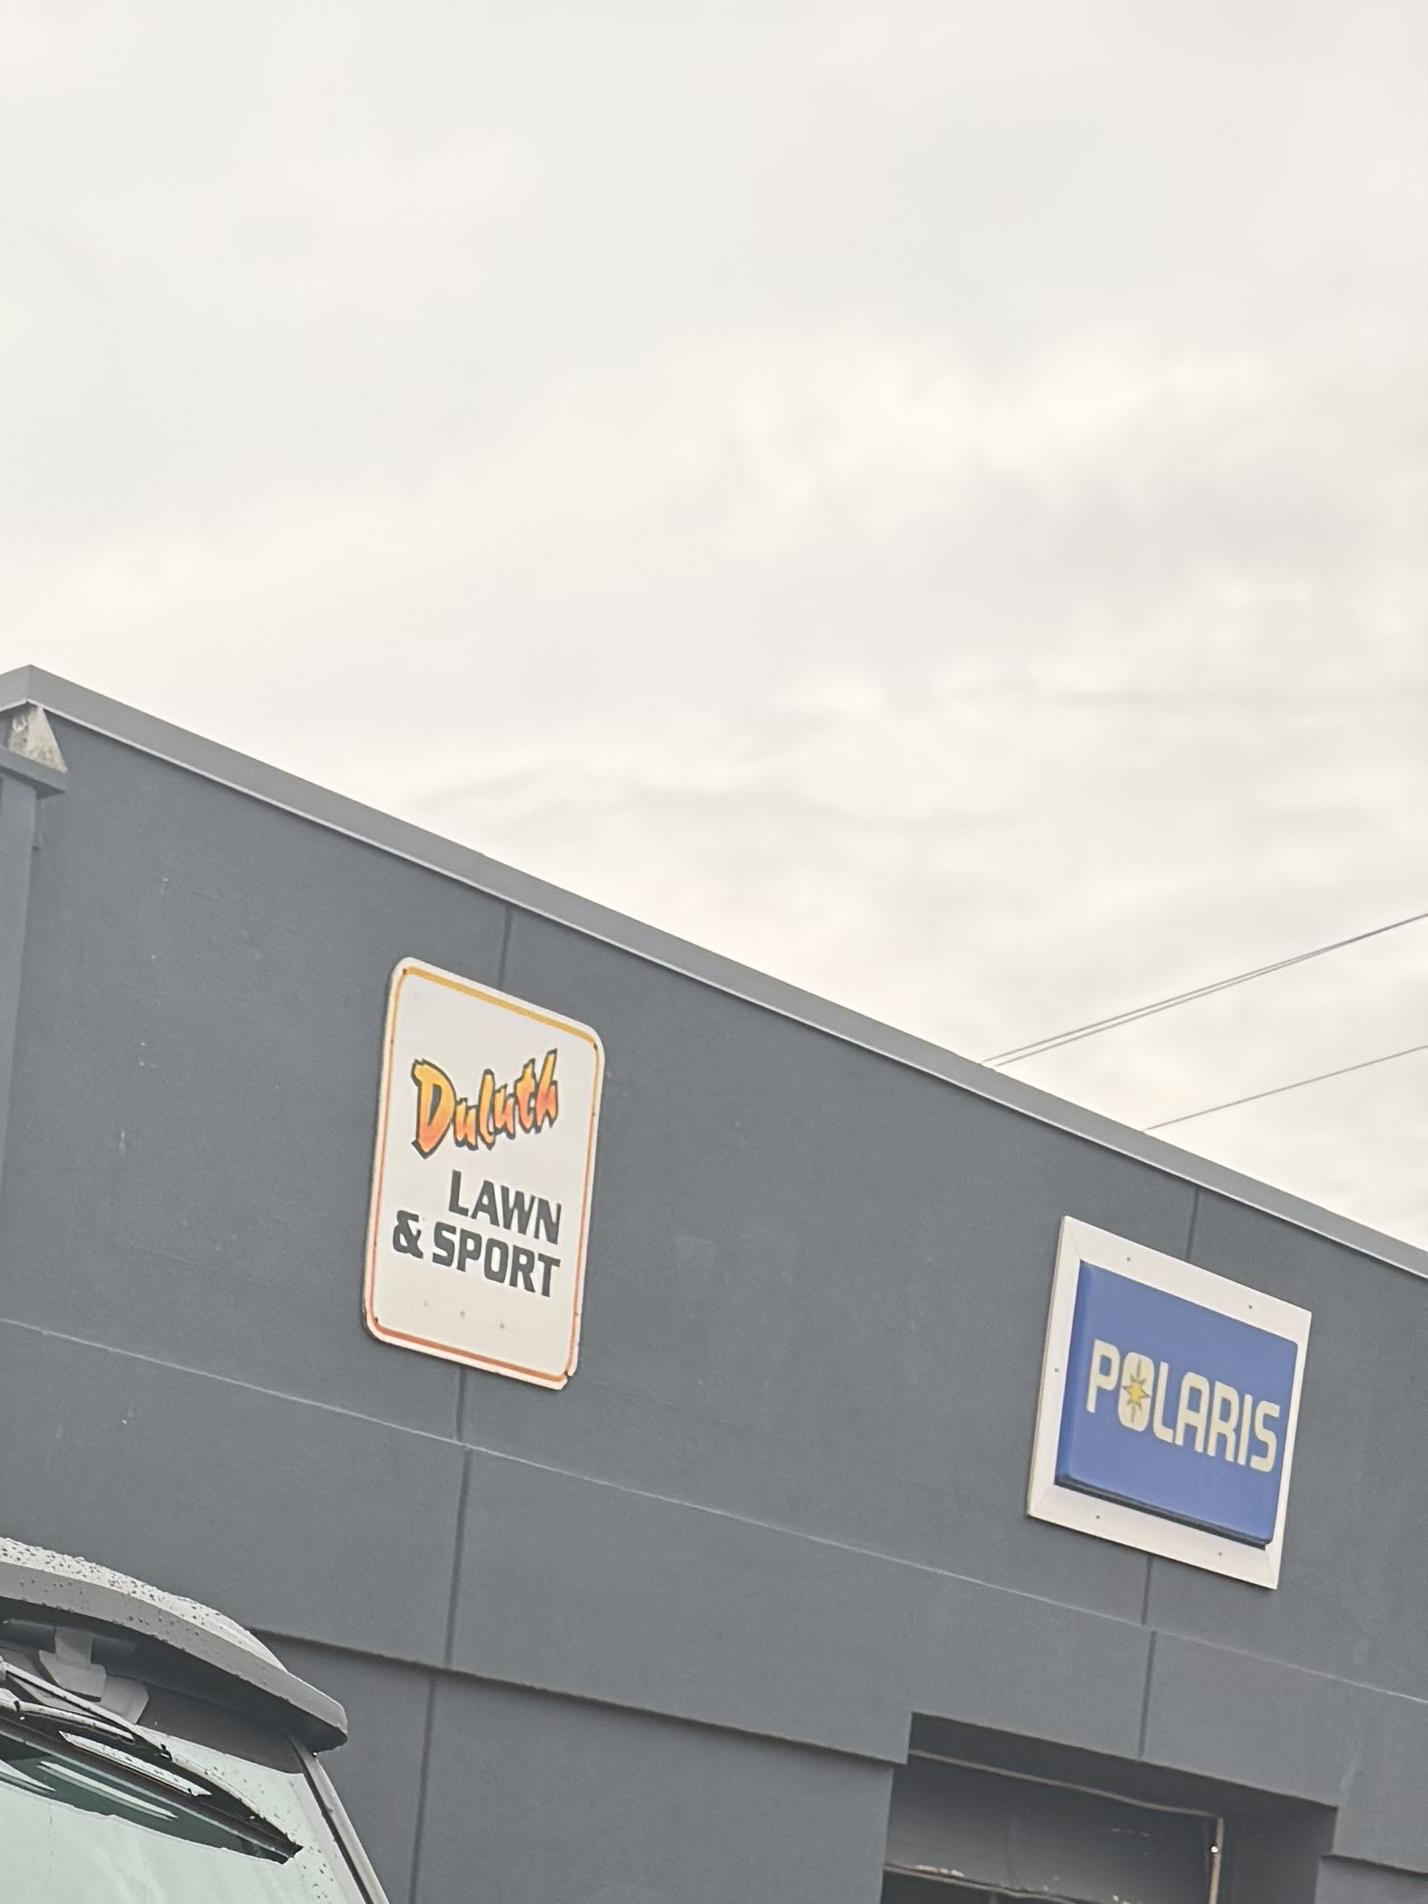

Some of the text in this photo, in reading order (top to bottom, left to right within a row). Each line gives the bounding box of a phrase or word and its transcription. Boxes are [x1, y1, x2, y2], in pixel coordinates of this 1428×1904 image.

[411, 1048, 559, 1159] Duluth
[392, 1210, 562, 1298] & SPORT
[447, 1169, 562, 1245] LAWN
[1086, 1338, 1281, 1473] POLARIS
